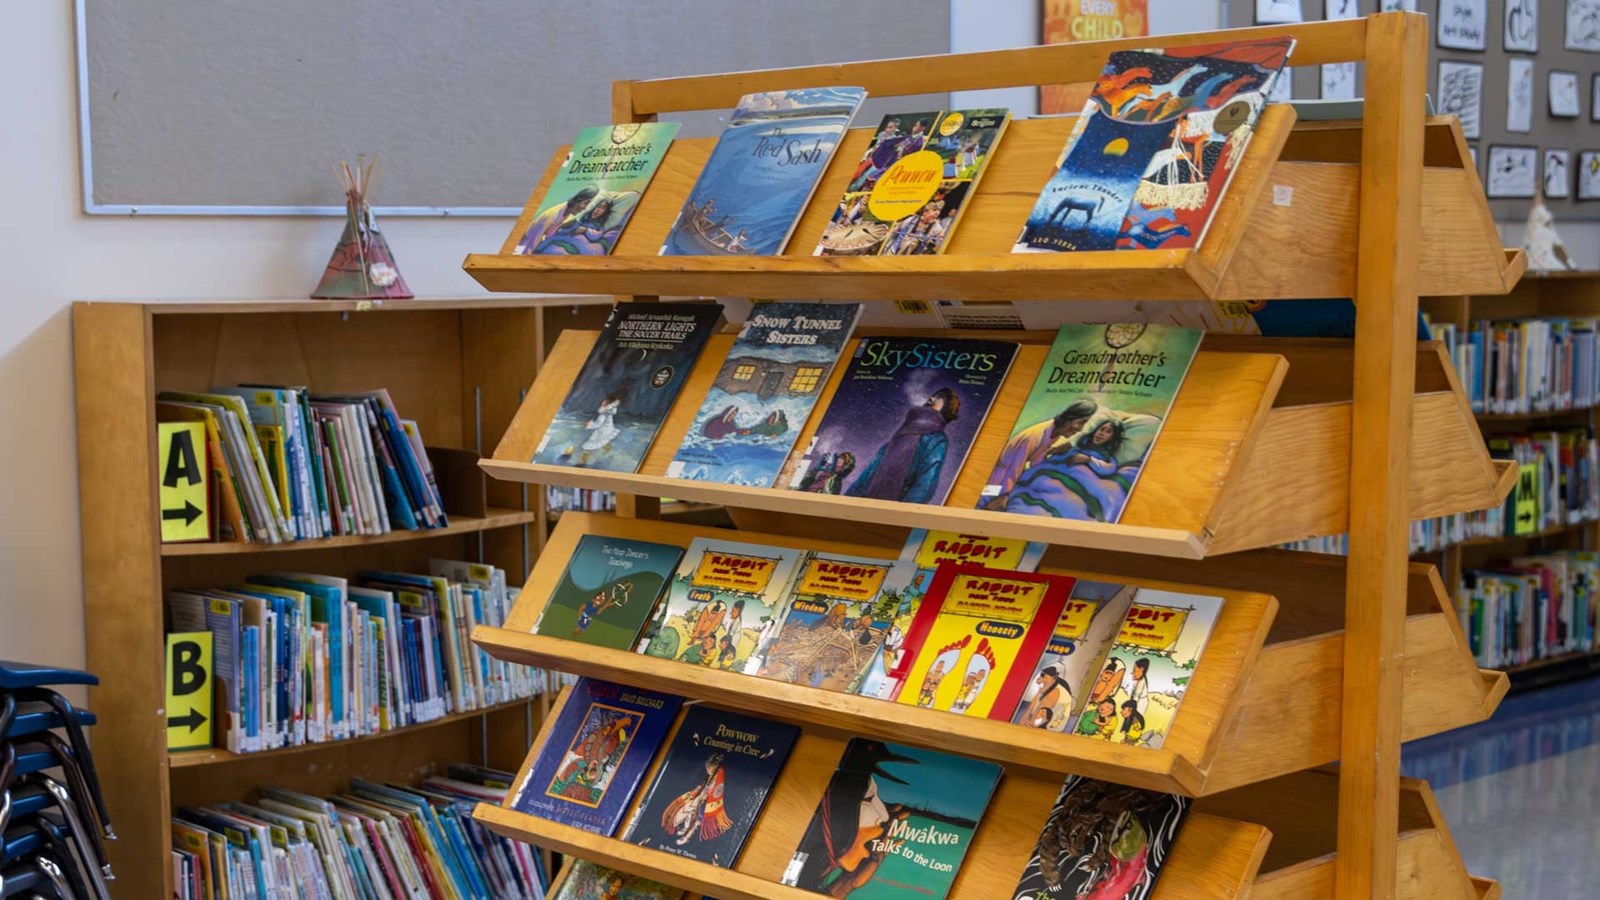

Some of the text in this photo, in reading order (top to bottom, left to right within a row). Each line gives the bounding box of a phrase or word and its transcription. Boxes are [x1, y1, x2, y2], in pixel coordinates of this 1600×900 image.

[1081, 0, 1117, 16] EVERY
[1071, 16, 1123, 40] CHILD
[581, 143, 652, 158] Grandmother's
[752, 136, 822, 166] Red Sash
[569, 157, 649, 174] Dreamcatcher
[1092, 184, 1123, 203] Thunder
[617, 321, 697, 332] NORTHERN LIGHTS
[634, 330, 660, 338] SOCCER
[660, 331, 688, 340] TRAILS
[1063, 349, 1167, 367] Grandmother's
[1047, 366, 1166, 388] Dreamcatcher
[163, 429, 202, 488] A
[933, 540, 1008, 559] RABBIT
[711, 556, 769, 571] RABBIT
[817, 563, 879, 579] RABBIT
[689, 590, 712, 601] Truth
[966, 580, 1034, 596] RABBIT
[794, 601, 826, 613] Wisdom
[1127, 607, 1175, 622] BBIT
[979, 622, 1019, 637] Honesty
[1048, 645, 1070, 654] rage
[172, 640, 207, 696] B
[703, 736, 735, 752] Counting
[743, 745, 760, 756] Cree
[887, 819, 960, 845] Mwâkwa
[872, 839, 953, 872] Talks to the Loon
